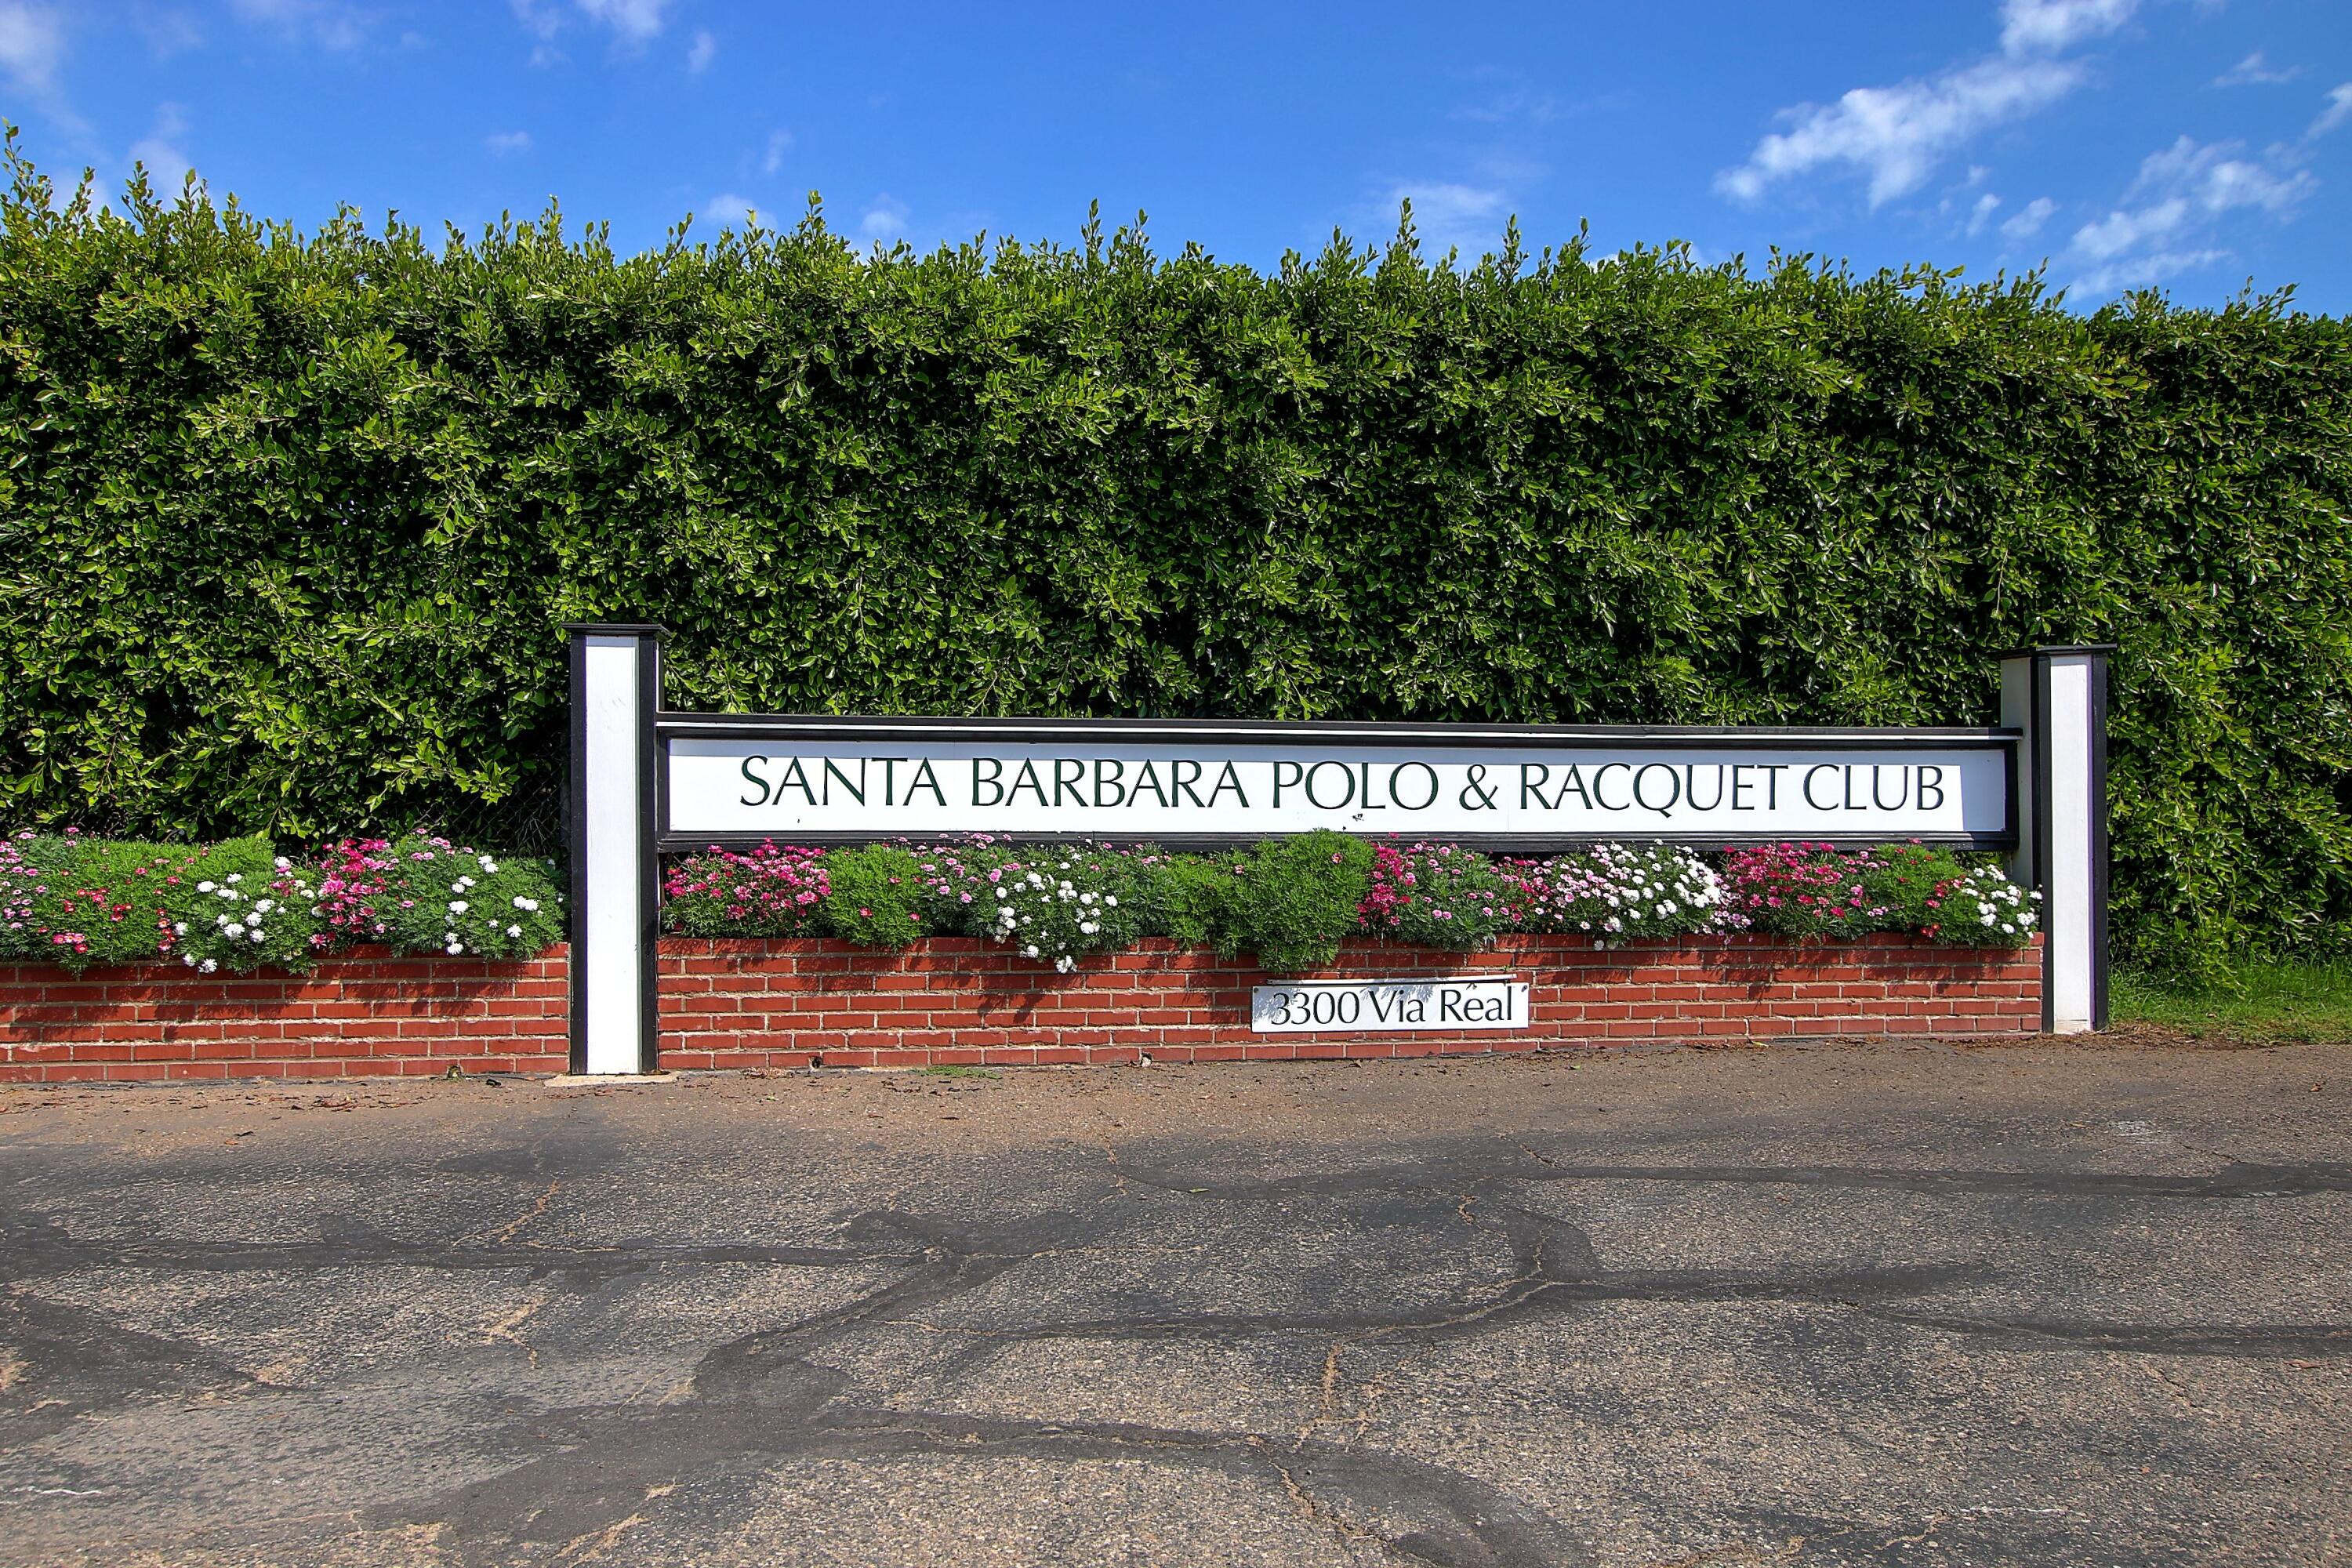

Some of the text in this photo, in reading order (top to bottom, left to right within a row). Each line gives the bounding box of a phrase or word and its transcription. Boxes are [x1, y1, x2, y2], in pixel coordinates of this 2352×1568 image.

[740, 754, 1944, 818] SANTA BARBARA POLO & RACQUET CLUB
[1271, 985, 1512, 1025] 3300 Via Real
